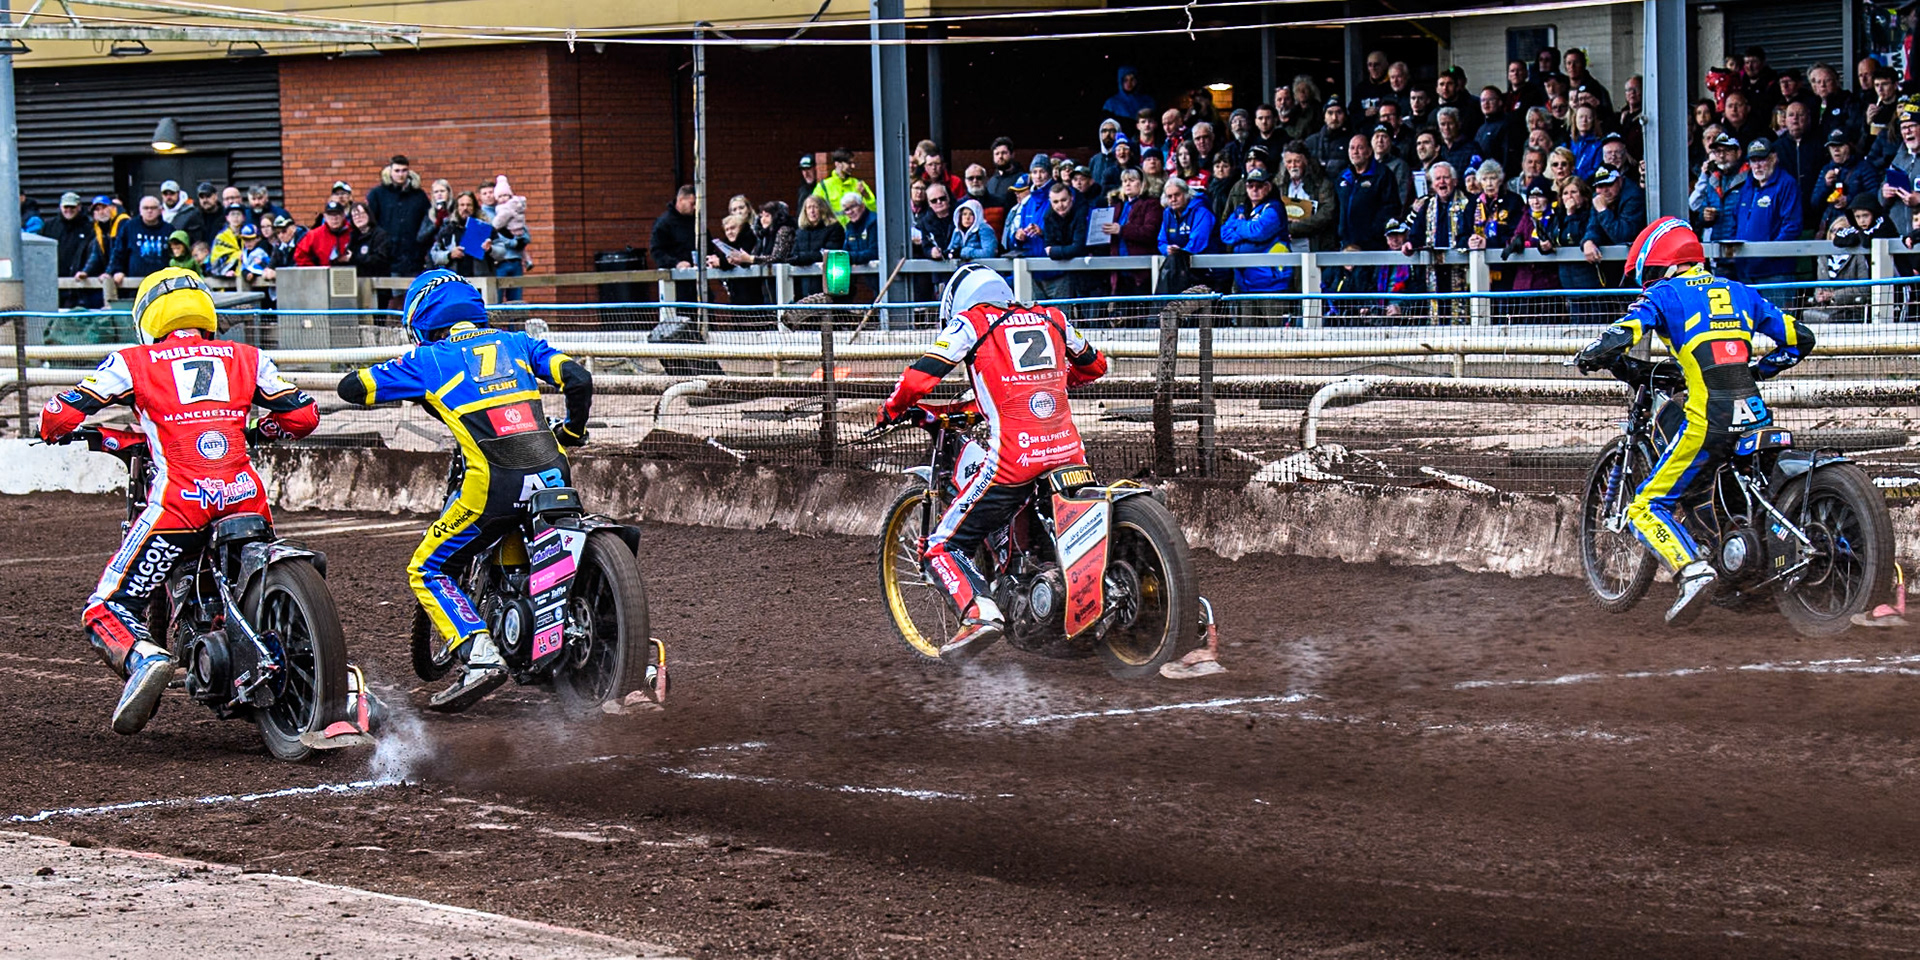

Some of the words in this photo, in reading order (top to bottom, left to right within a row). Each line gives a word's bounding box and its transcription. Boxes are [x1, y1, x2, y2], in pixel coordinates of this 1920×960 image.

[1707, 288, 1734, 315] 2
[1710, 321, 1741, 329] ROWE
[149, 345, 234, 363] MULFORD
[472, 344, 498, 378] 7
[1013, 330, 1052, 368] 2
[182, 360, 214, 399] 7
[164, 409, 245, 421] MANCHESTER
[1732, 396, 1767, 425] AB
[126, 535, 170, 597] HAGON
